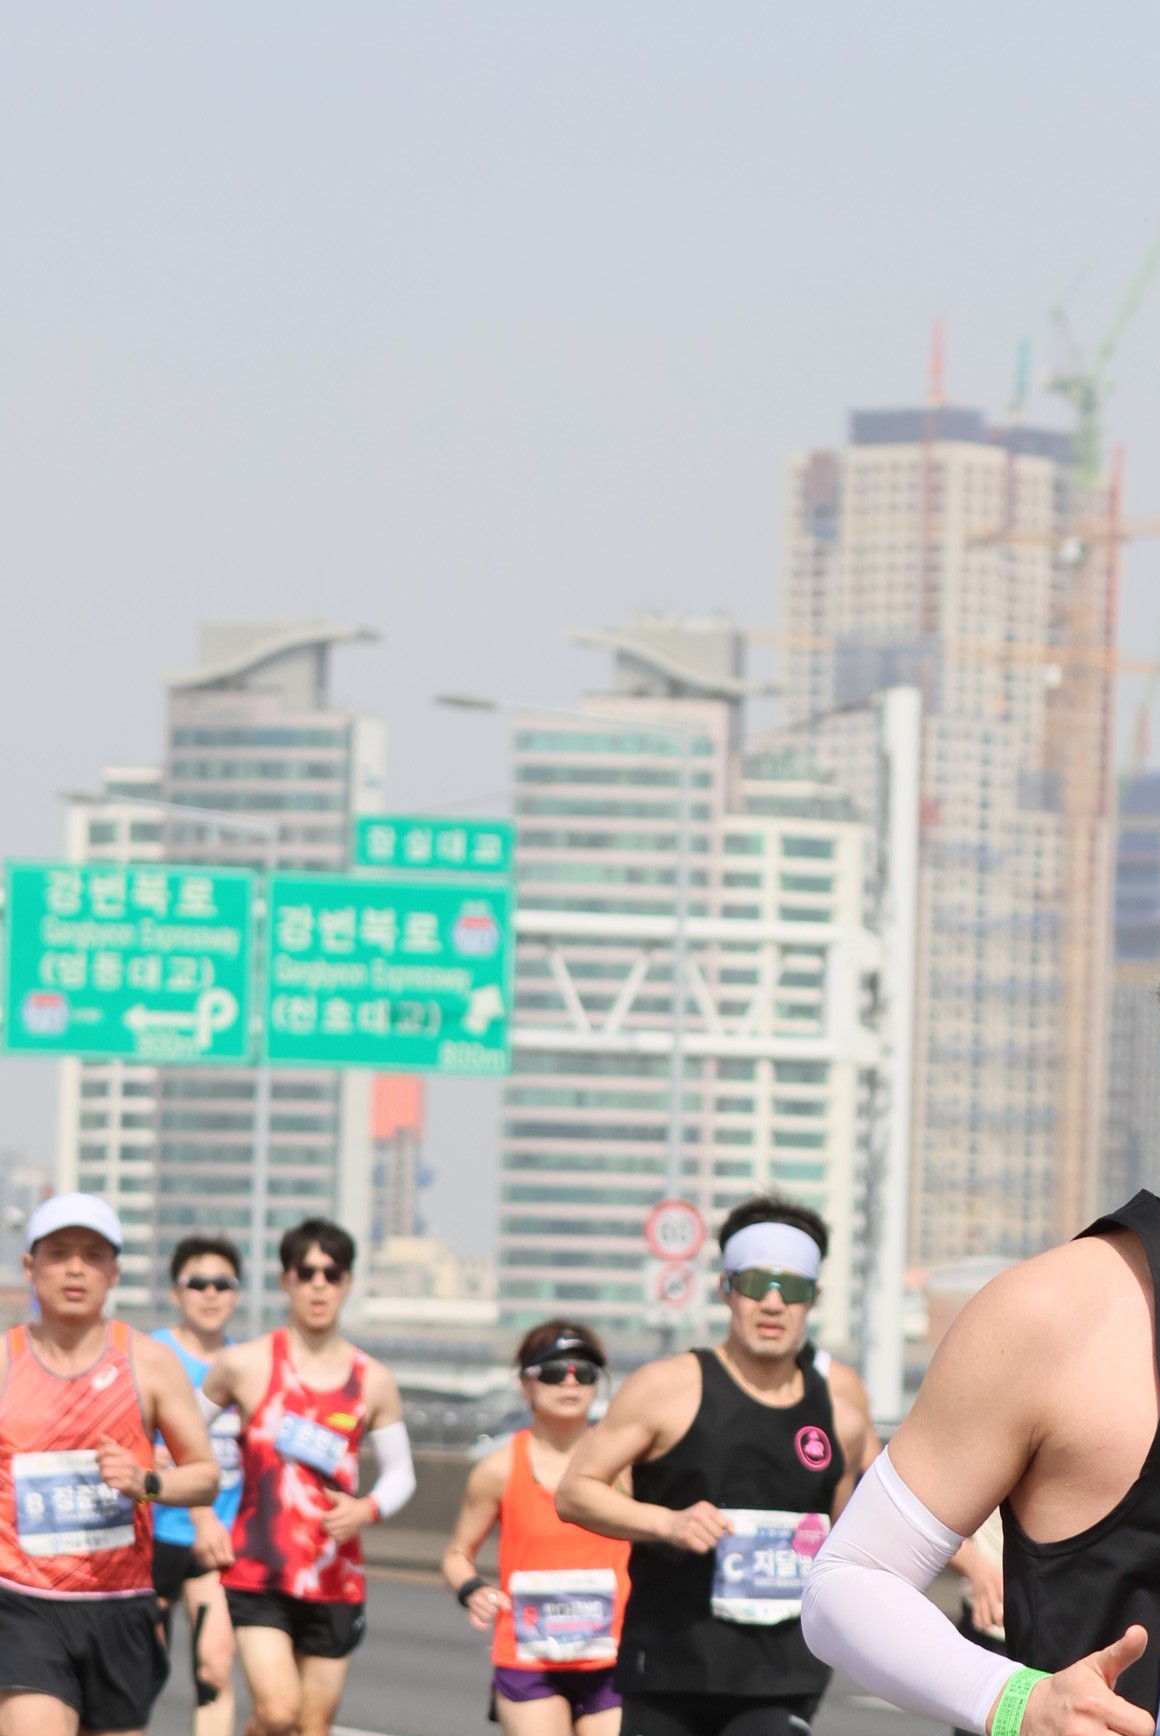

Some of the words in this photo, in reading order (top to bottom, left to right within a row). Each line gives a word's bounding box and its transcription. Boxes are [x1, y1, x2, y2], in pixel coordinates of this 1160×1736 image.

[44, 869, 218, 918] 강변북로
[278, 903, 443, 955] 강변북로
[722, 1552, 745, 1583] C
